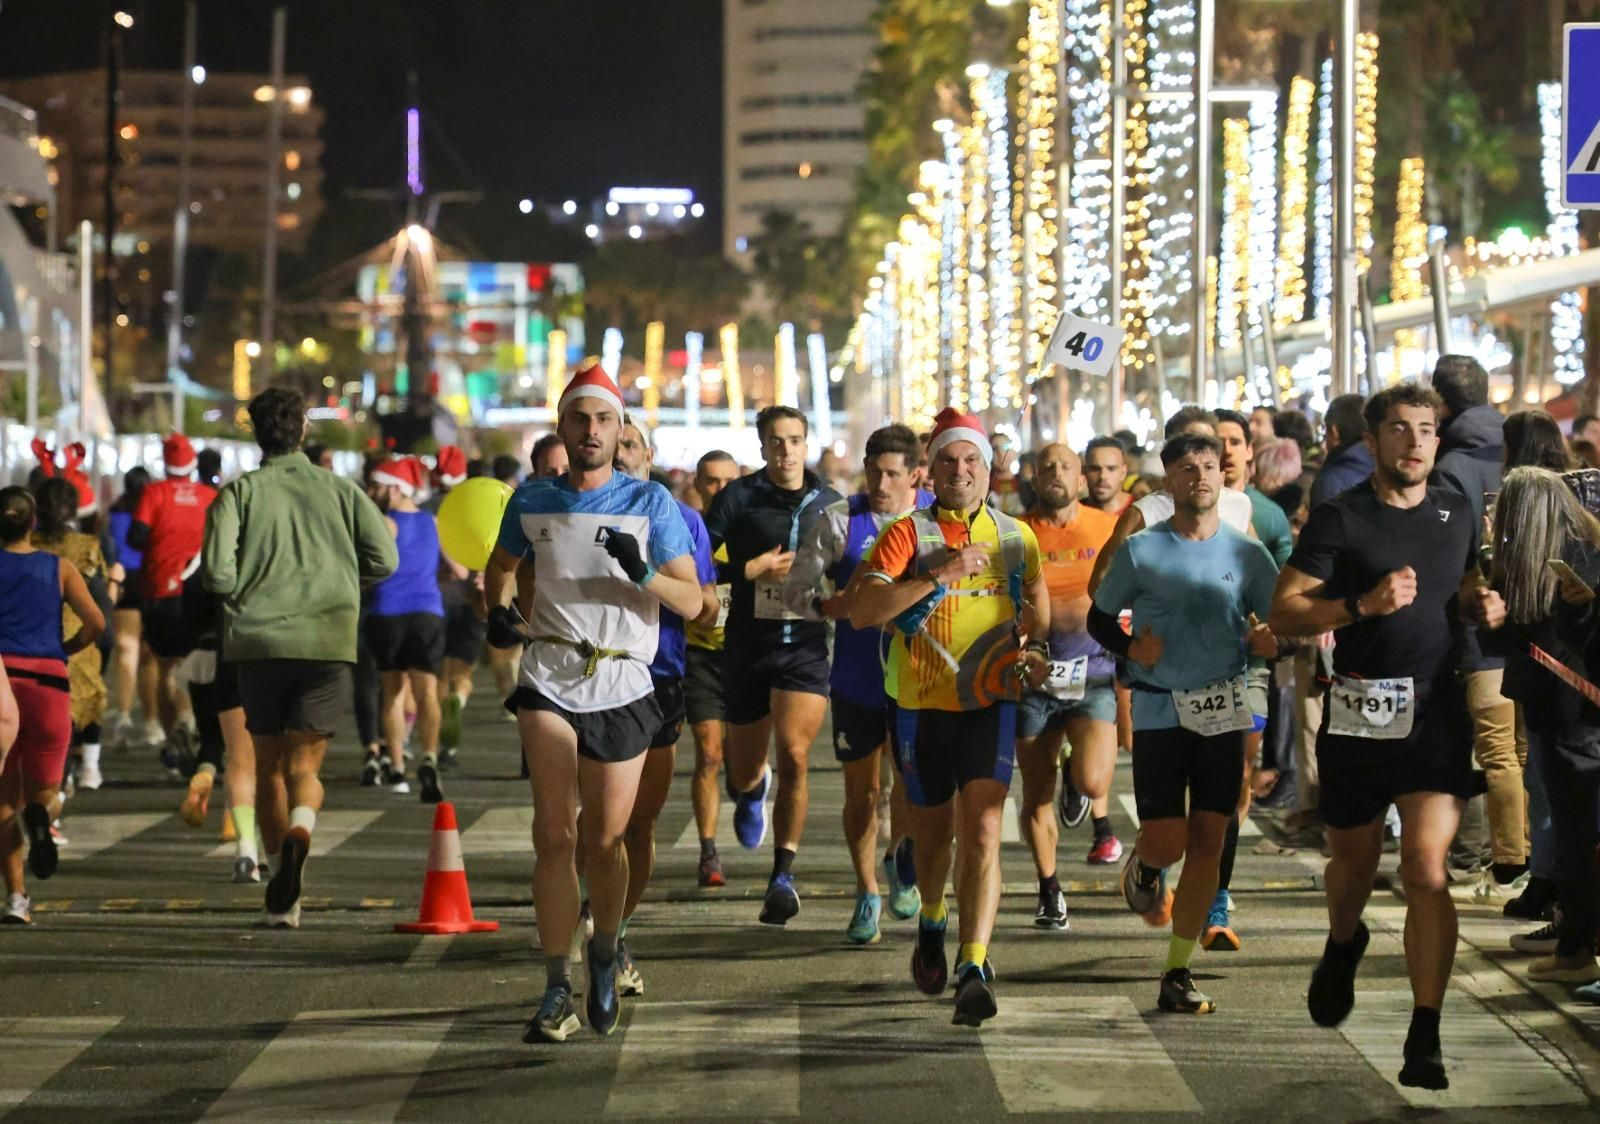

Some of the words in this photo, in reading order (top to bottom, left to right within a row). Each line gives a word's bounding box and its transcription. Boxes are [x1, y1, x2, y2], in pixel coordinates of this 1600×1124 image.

[1064, 330, 1104, 362] 40
[1190, 694, 1227, 715] 342
[1341, 694, 1393, 713] 1191
